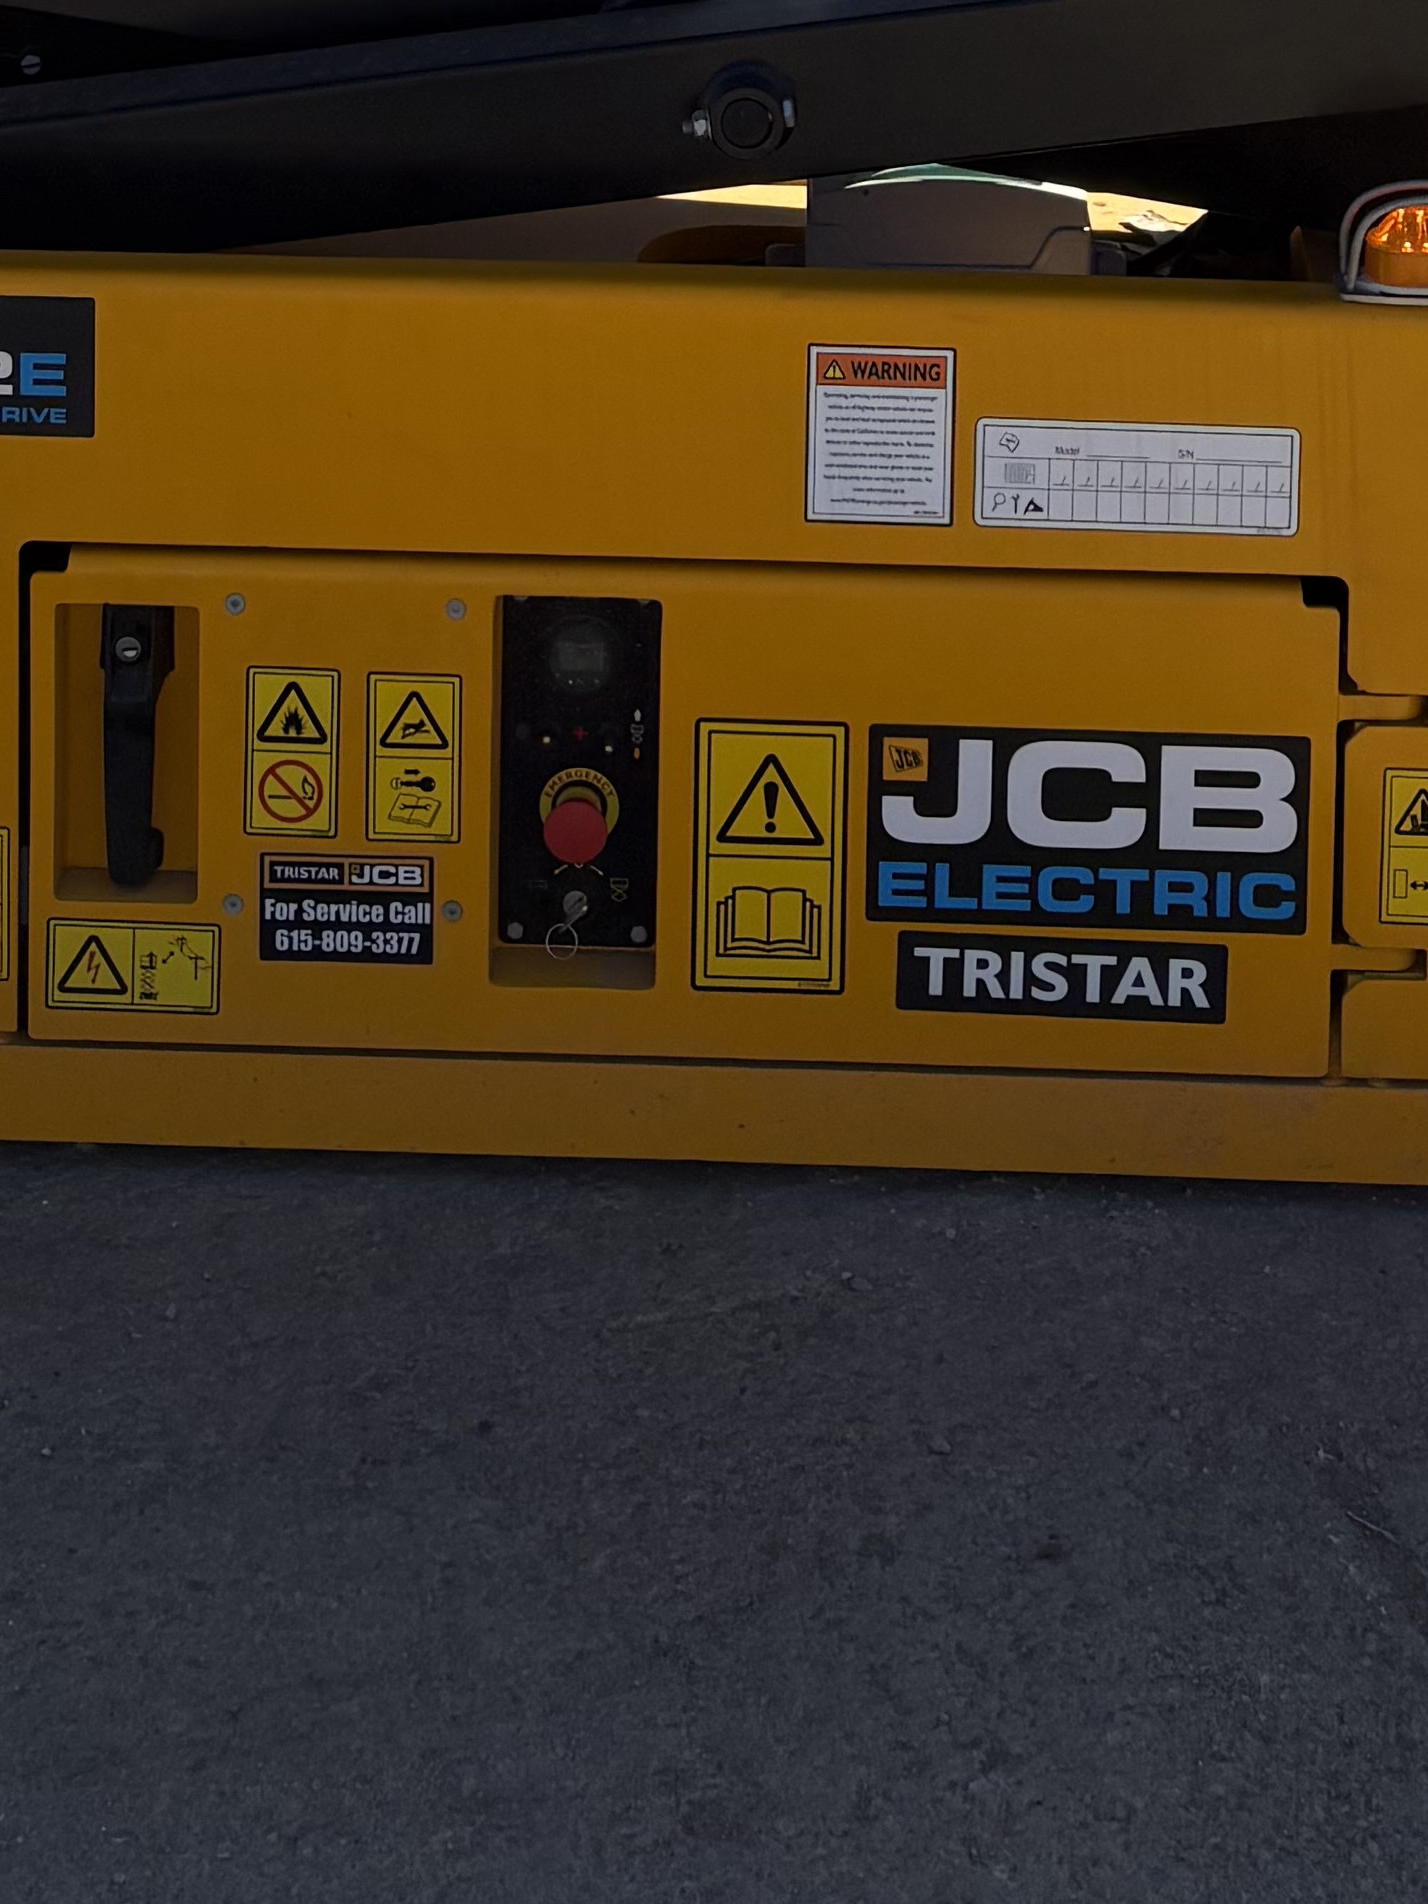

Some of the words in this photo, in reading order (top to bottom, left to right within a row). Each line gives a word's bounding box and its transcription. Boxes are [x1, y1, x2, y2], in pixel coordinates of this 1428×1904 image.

[851, 360, 941, 382] WARNING
[881, 739, 1298, 853] JCB
[274, 865, 339, 880] TRISTAR
[351, 865, 422, 885] JCB
[878, 861, 1296, 920] ELECTRIC
[264, 898, 298, 921] For
[302, 899, 384, 923] Service
[389, 901, 431, 925] Call
[275, 929, 420, 955] 615-809-3377
[913, 947, 1210, 1008] TRISTAR
